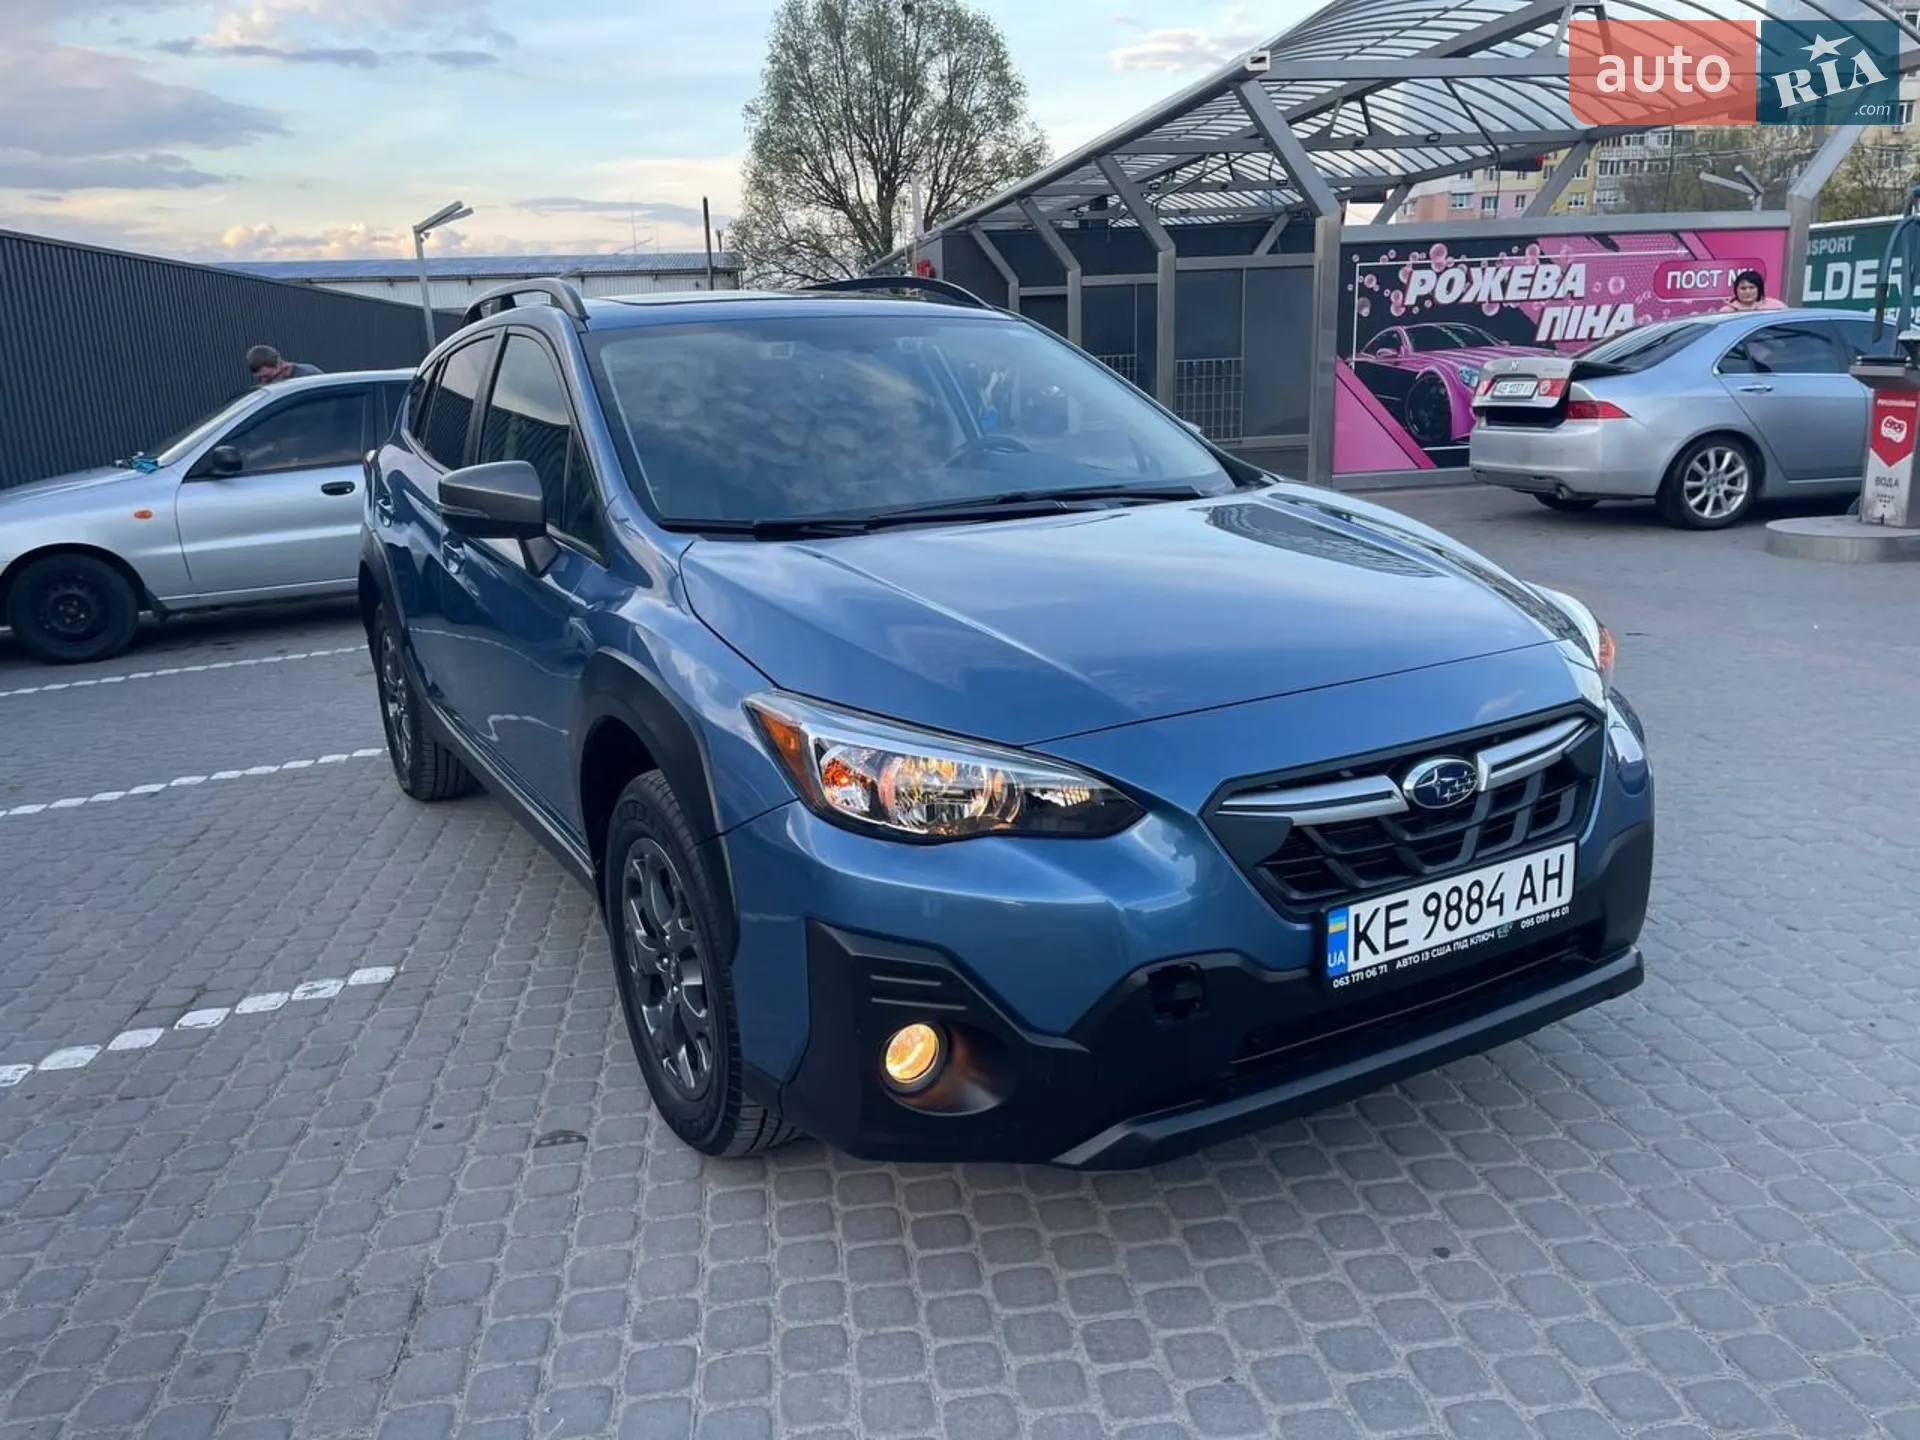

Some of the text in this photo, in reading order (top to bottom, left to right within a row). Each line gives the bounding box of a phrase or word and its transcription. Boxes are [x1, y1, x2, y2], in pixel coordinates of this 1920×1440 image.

[1404, 263, 1586, 305] РОЖЕВА
[1667, 269, 1722, 290] ПОСТ
[1536, 303, 1635, 342] ПІНА
[1353, 853, 1565, 962] KE 9884 AH
[1328, 950, 1345, 967] UA
[1333, 976, 1350, 988] 063
[1351, 971, 1364, 983] 171
[1378, 964, 1388, 975] 71
[1396, 955, 1420, 969] АВТО
[1431, 944, 1452, 958] США
[1453, 940, 1469, 952] ПІД
[1470, 930, 1495, 946] КЛЮЧ
